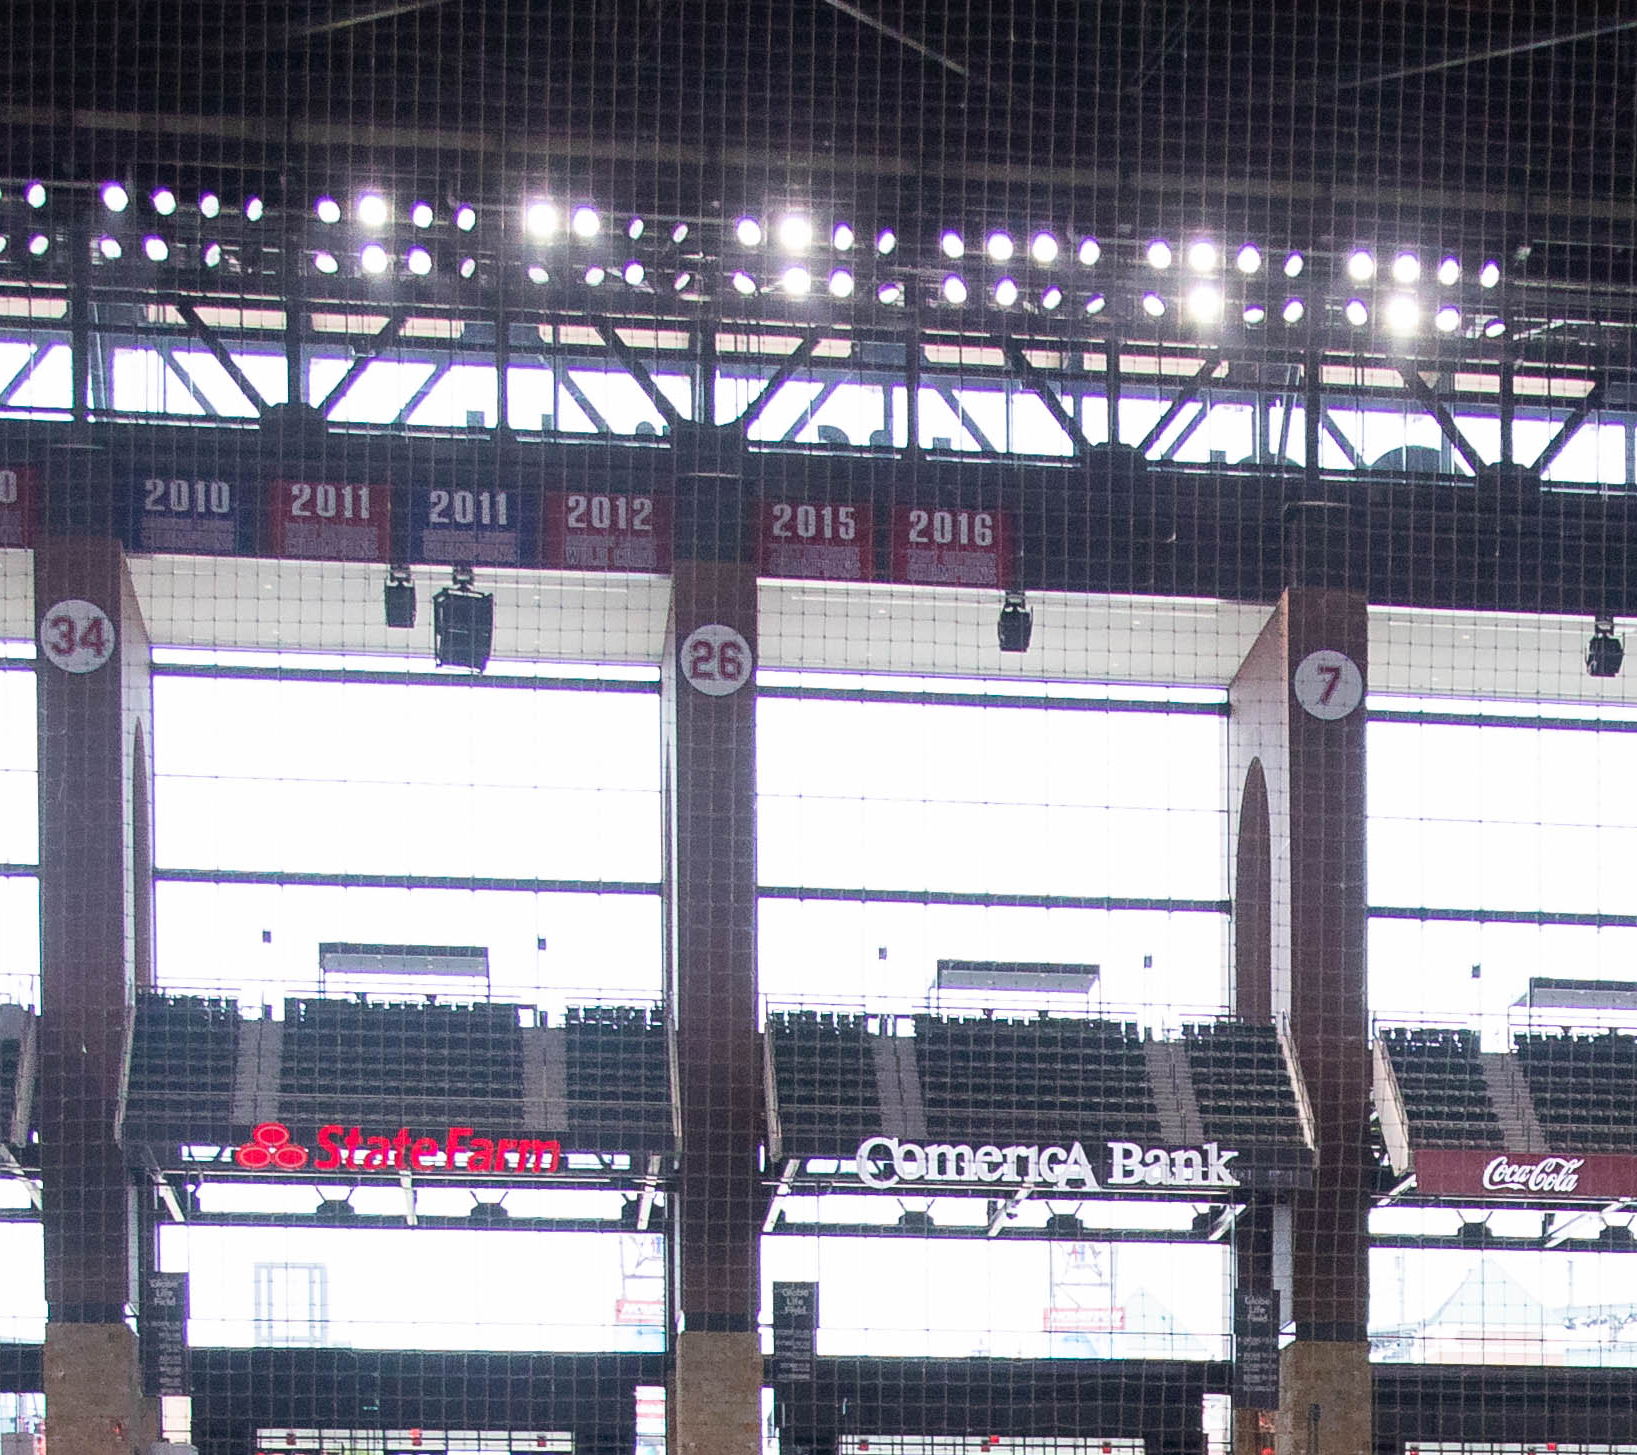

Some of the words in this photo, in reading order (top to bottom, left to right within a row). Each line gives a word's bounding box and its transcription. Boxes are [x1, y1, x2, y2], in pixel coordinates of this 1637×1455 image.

[144, 479, 231, 513] 2010
[290, 483, 371, 519] 2011
[428, 490, 509, 525] 2011
[567, 495, 653, 531] 2012
[771, 504, 857, 540] 2015
[908, 510, 993, 545] 2016
[50, 615, 106, 660] 34
[690, 641, 742, 682] 26
[1317, 667, 1342, 705] 7
[1108, 1142, 1240, 1187] Bank
[1482, 1155, 1586, 1193] Coca-Cola
